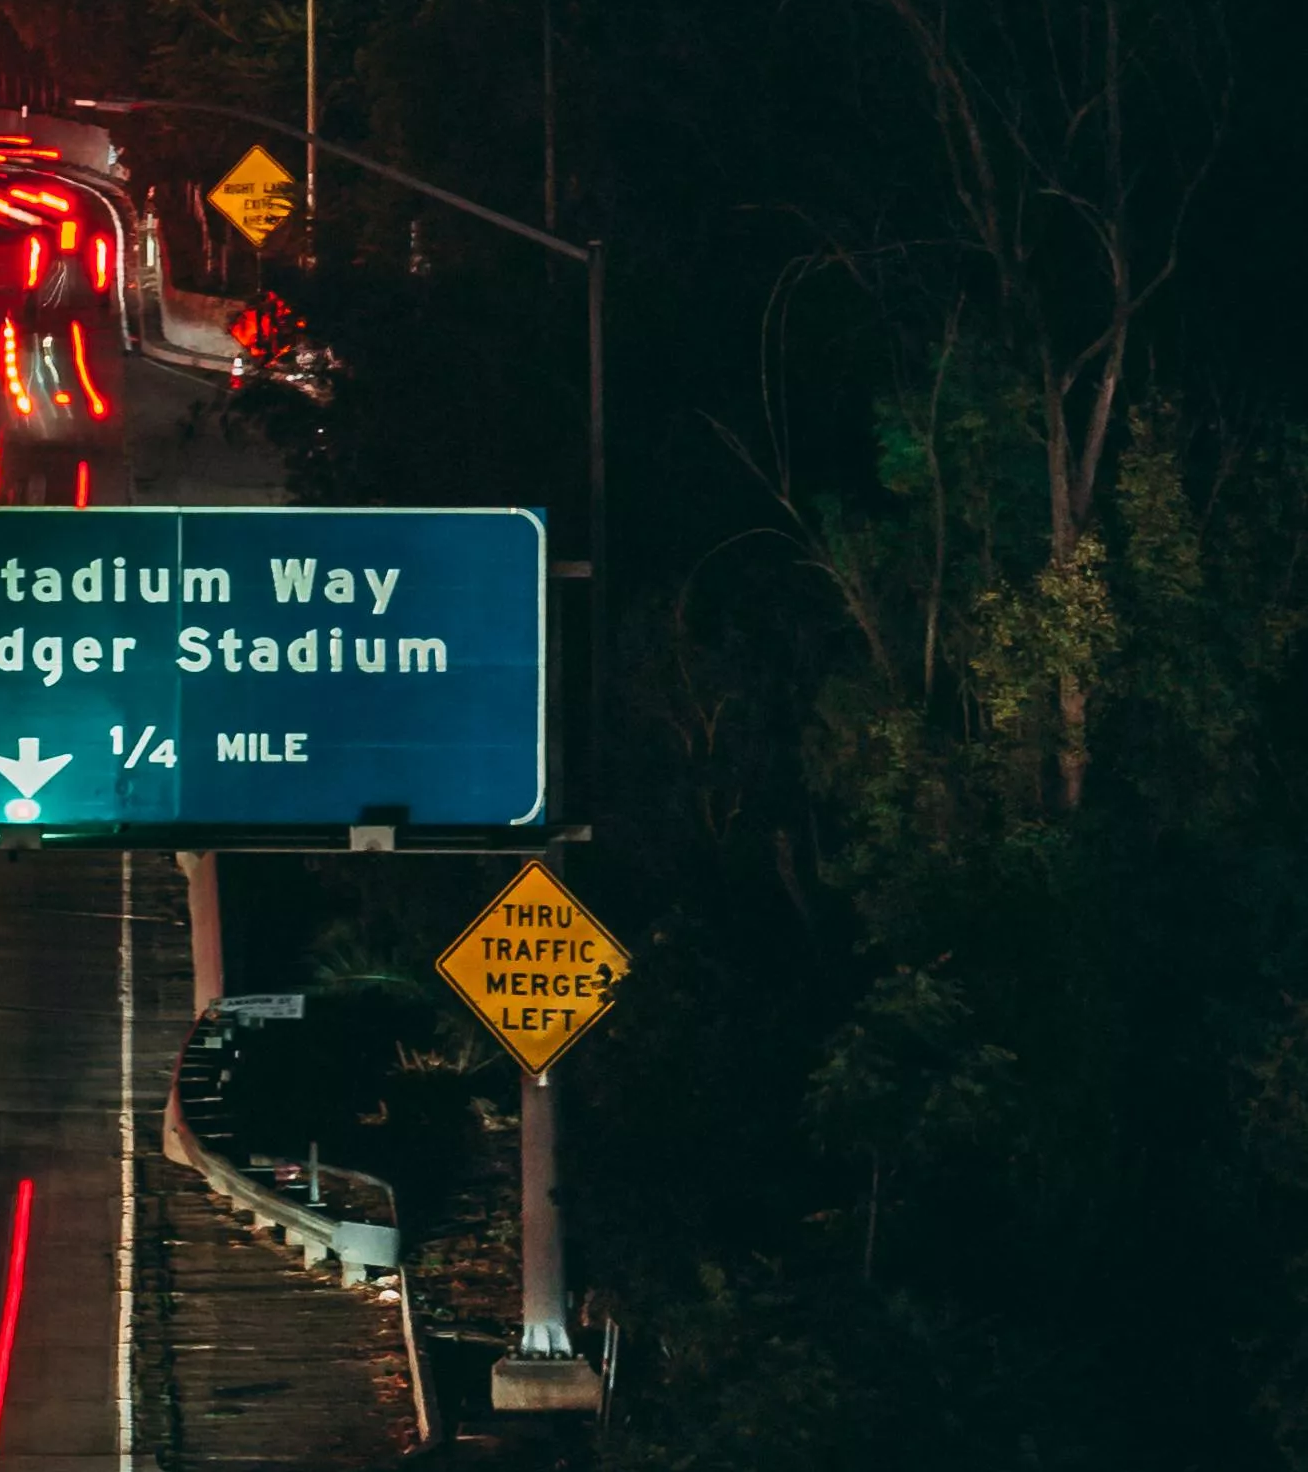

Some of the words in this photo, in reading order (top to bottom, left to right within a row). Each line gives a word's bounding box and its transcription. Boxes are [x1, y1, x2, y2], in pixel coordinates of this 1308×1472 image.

[271, 558, 400, 614] Way
[176, 627, 447, 672] Stadium
[218, 733, 308, 761] MILE
[503, 904, 571, 928] THRU
[481, 937, 594, 963] TRAFFIC
[487, 972, 591, 997] MERGE
[502, 1008, 576, 1032] LEFT
